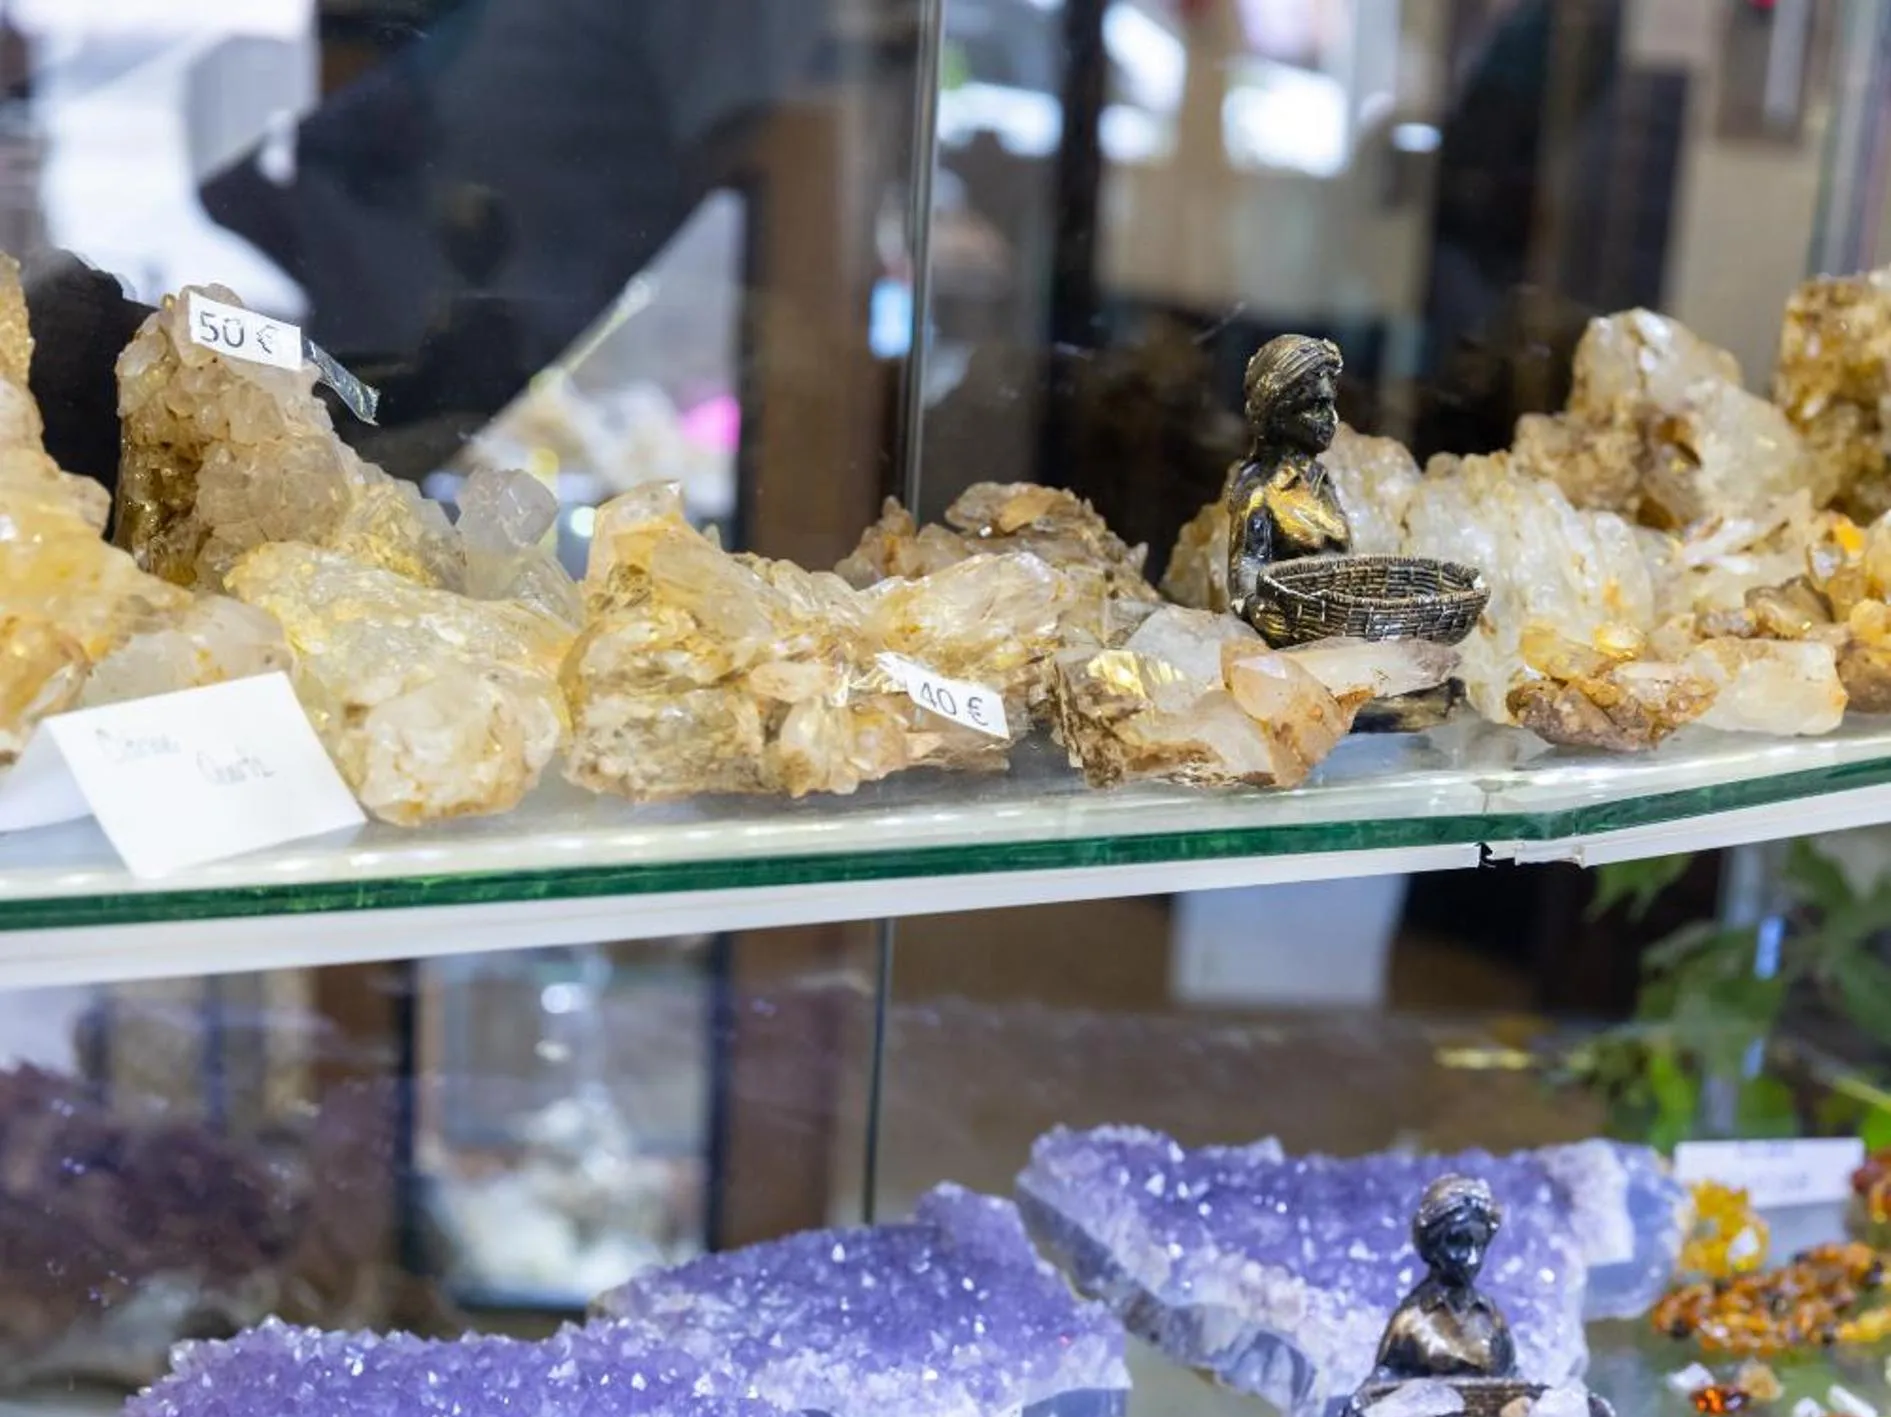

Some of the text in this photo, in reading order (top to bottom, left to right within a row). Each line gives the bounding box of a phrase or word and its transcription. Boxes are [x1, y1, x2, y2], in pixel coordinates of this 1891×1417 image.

[199, 311, 279, 354] 50 €
[920, 681, 989, 726] 40 €
